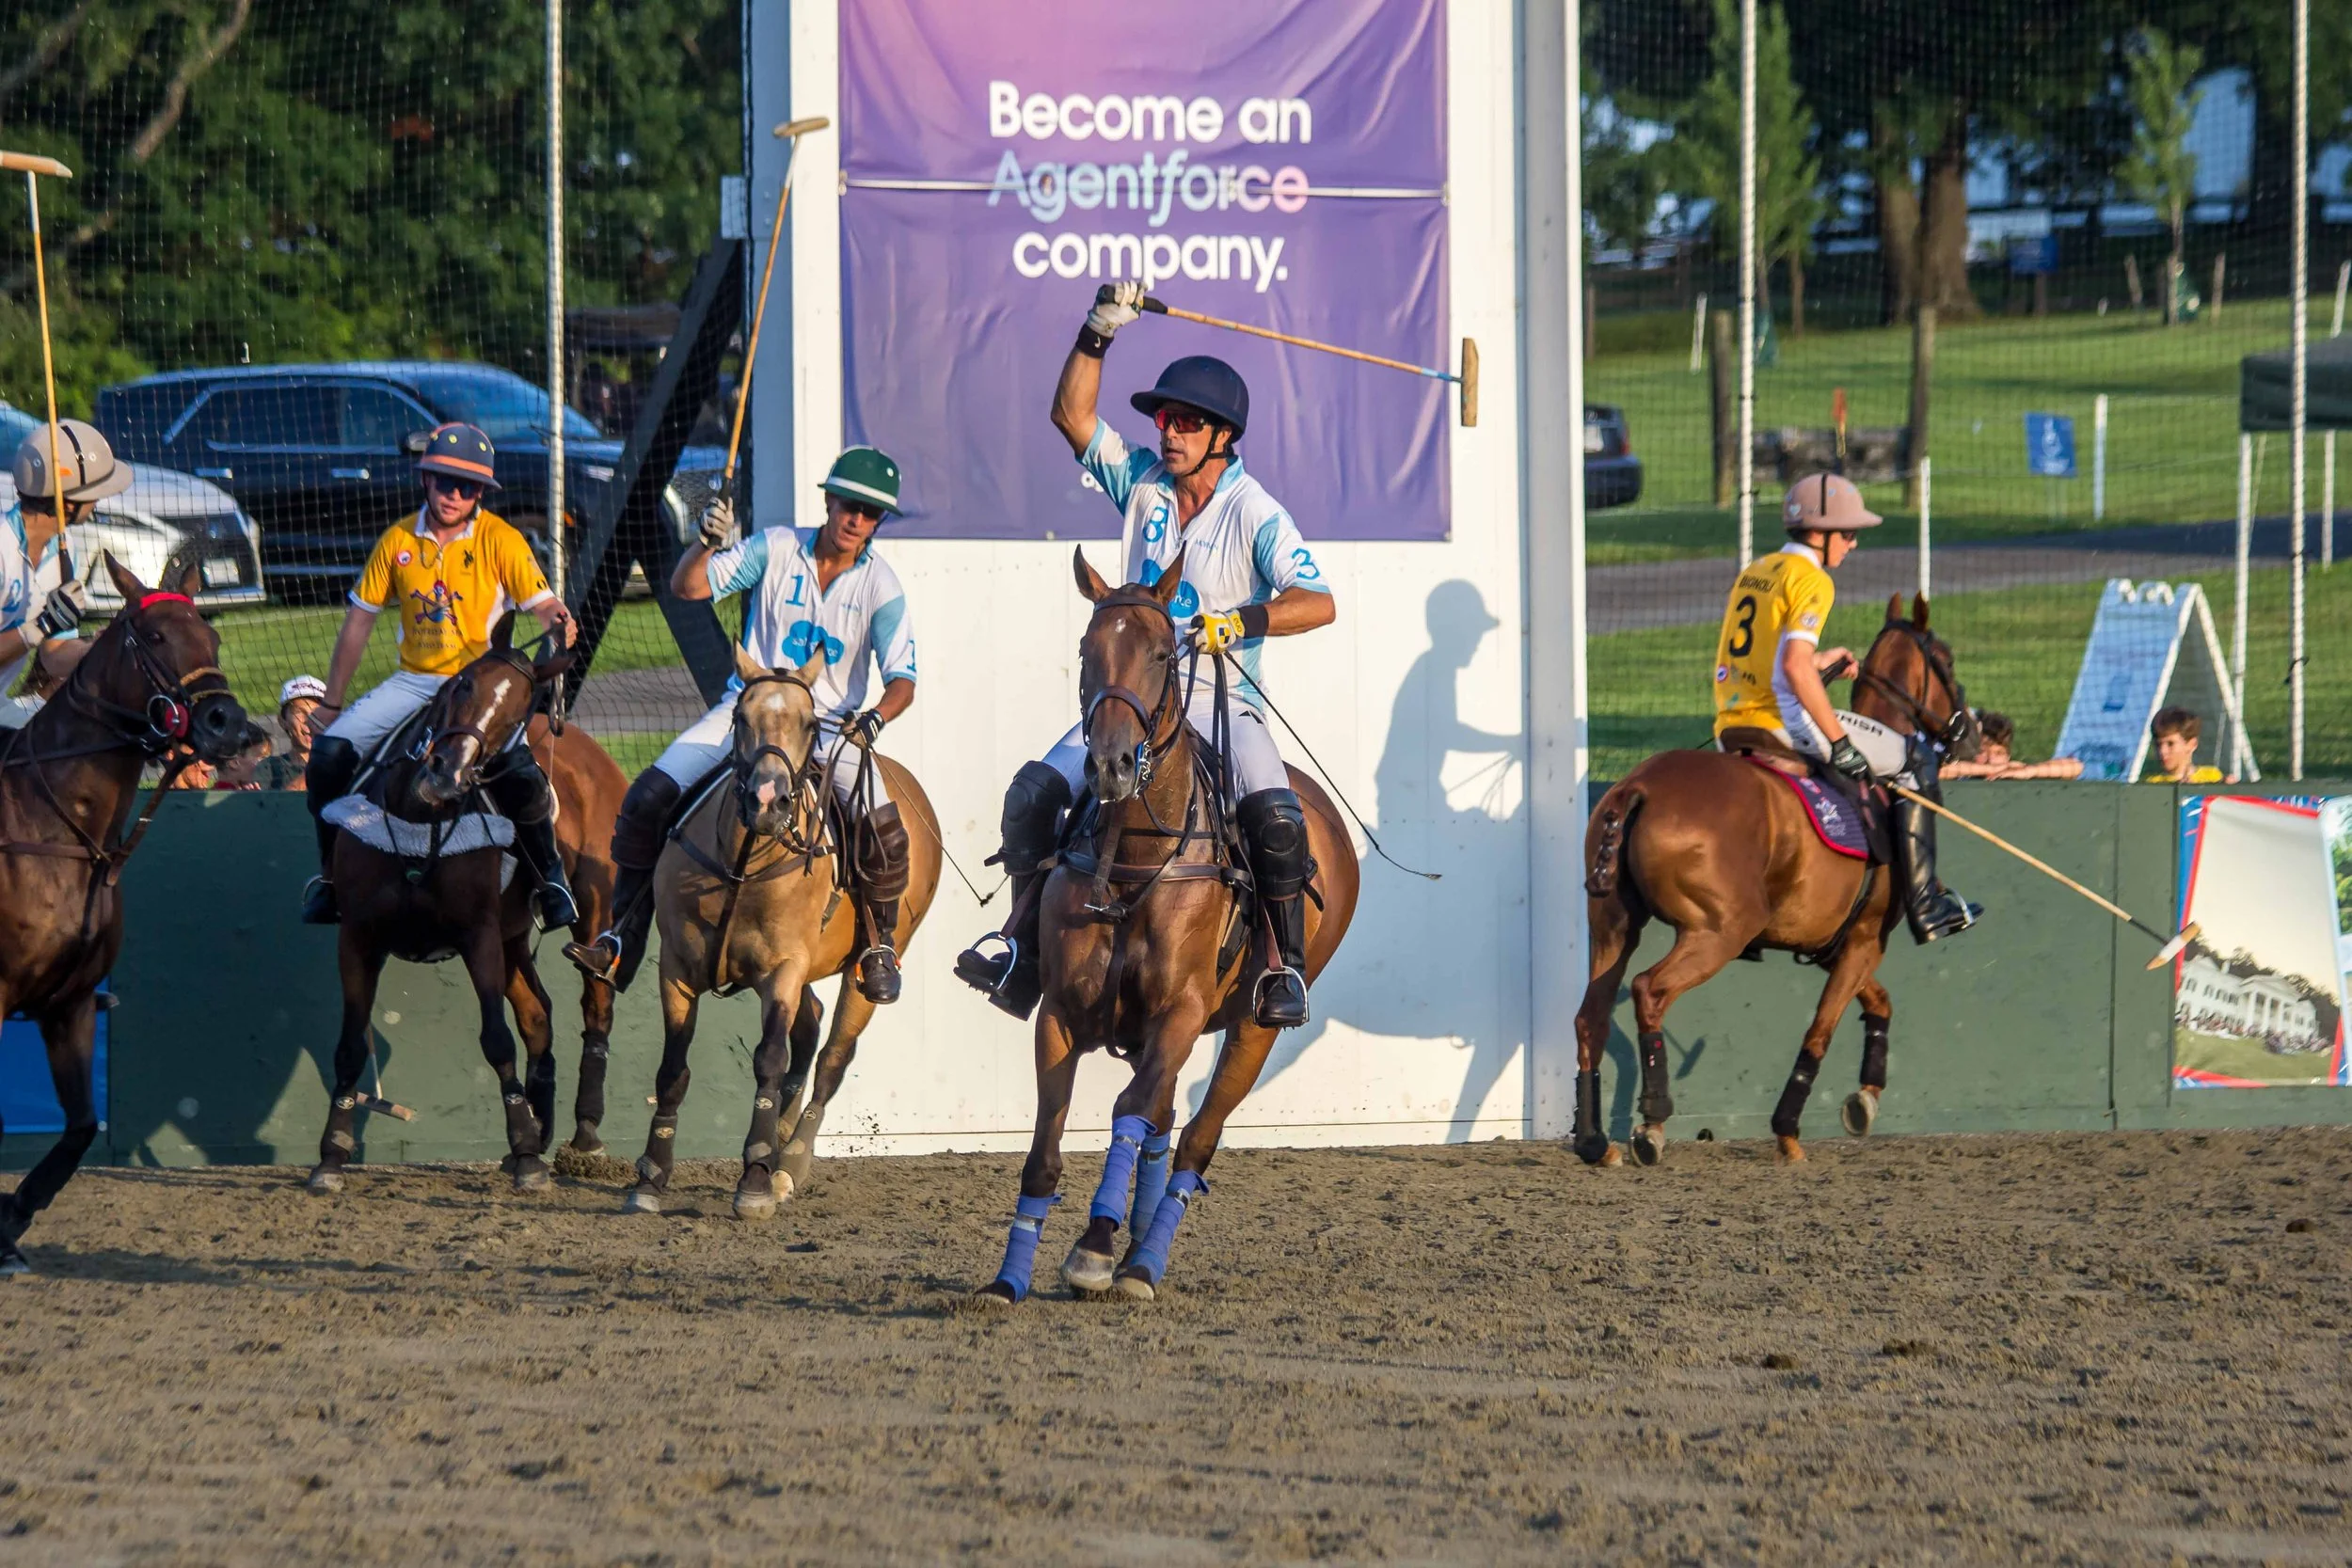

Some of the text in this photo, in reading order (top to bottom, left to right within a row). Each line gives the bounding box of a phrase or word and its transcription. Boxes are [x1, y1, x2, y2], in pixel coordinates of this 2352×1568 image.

[989, 80, 1312, 144] Become an
[986, 149, 1310, 228] Agentforce
[1012, 231, 1289, 293] company.
[785, 575, 805, 607] 1
[1291, 547, 1320, 580] 3
[906, 640, 917, 673] 1
[1728, 594, 1757, 657] 3
